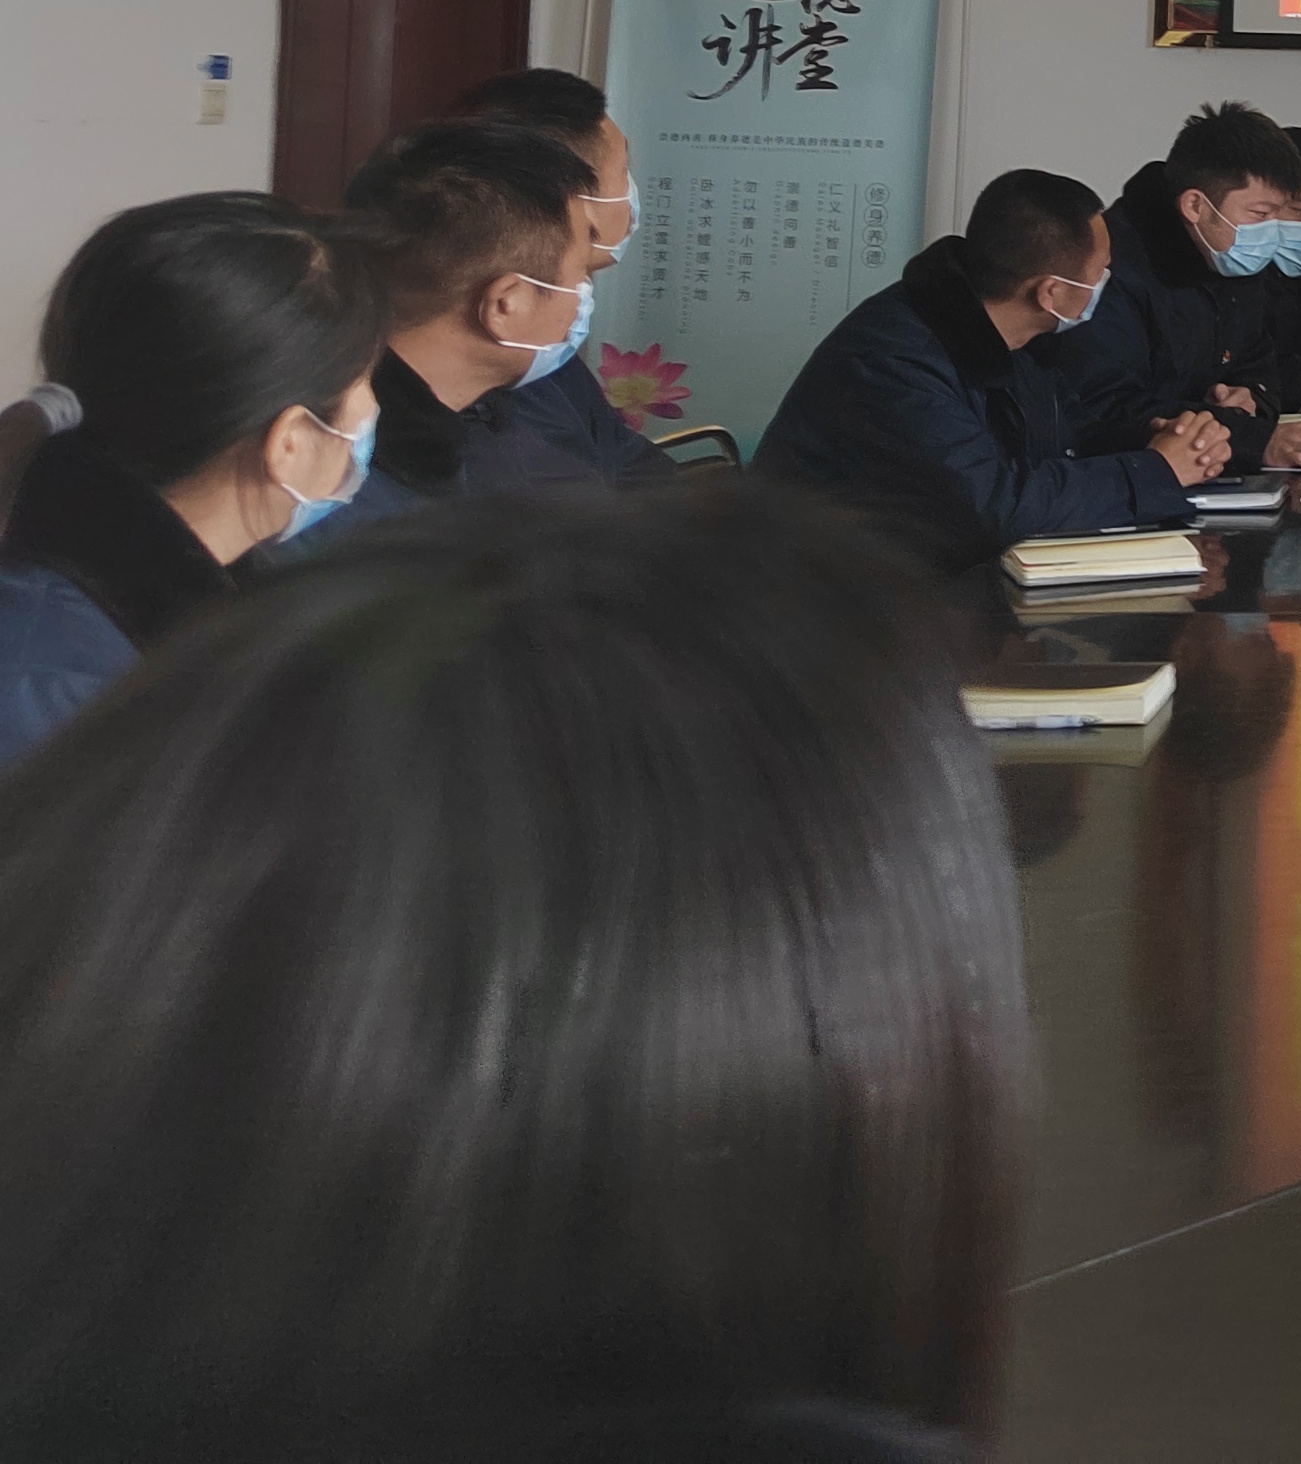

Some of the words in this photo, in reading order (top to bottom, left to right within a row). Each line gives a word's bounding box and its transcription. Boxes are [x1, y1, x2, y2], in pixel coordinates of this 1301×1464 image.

[686, 3, 849, 102] 讲堂
[649, 177, 673, 300] 程门立雪求贤才
[736, 180, 759, 303] 勿以善小而不为
[824, 182, 844, 268] 仁义礼智信
[862, 183, 889, 267] 修身养德
